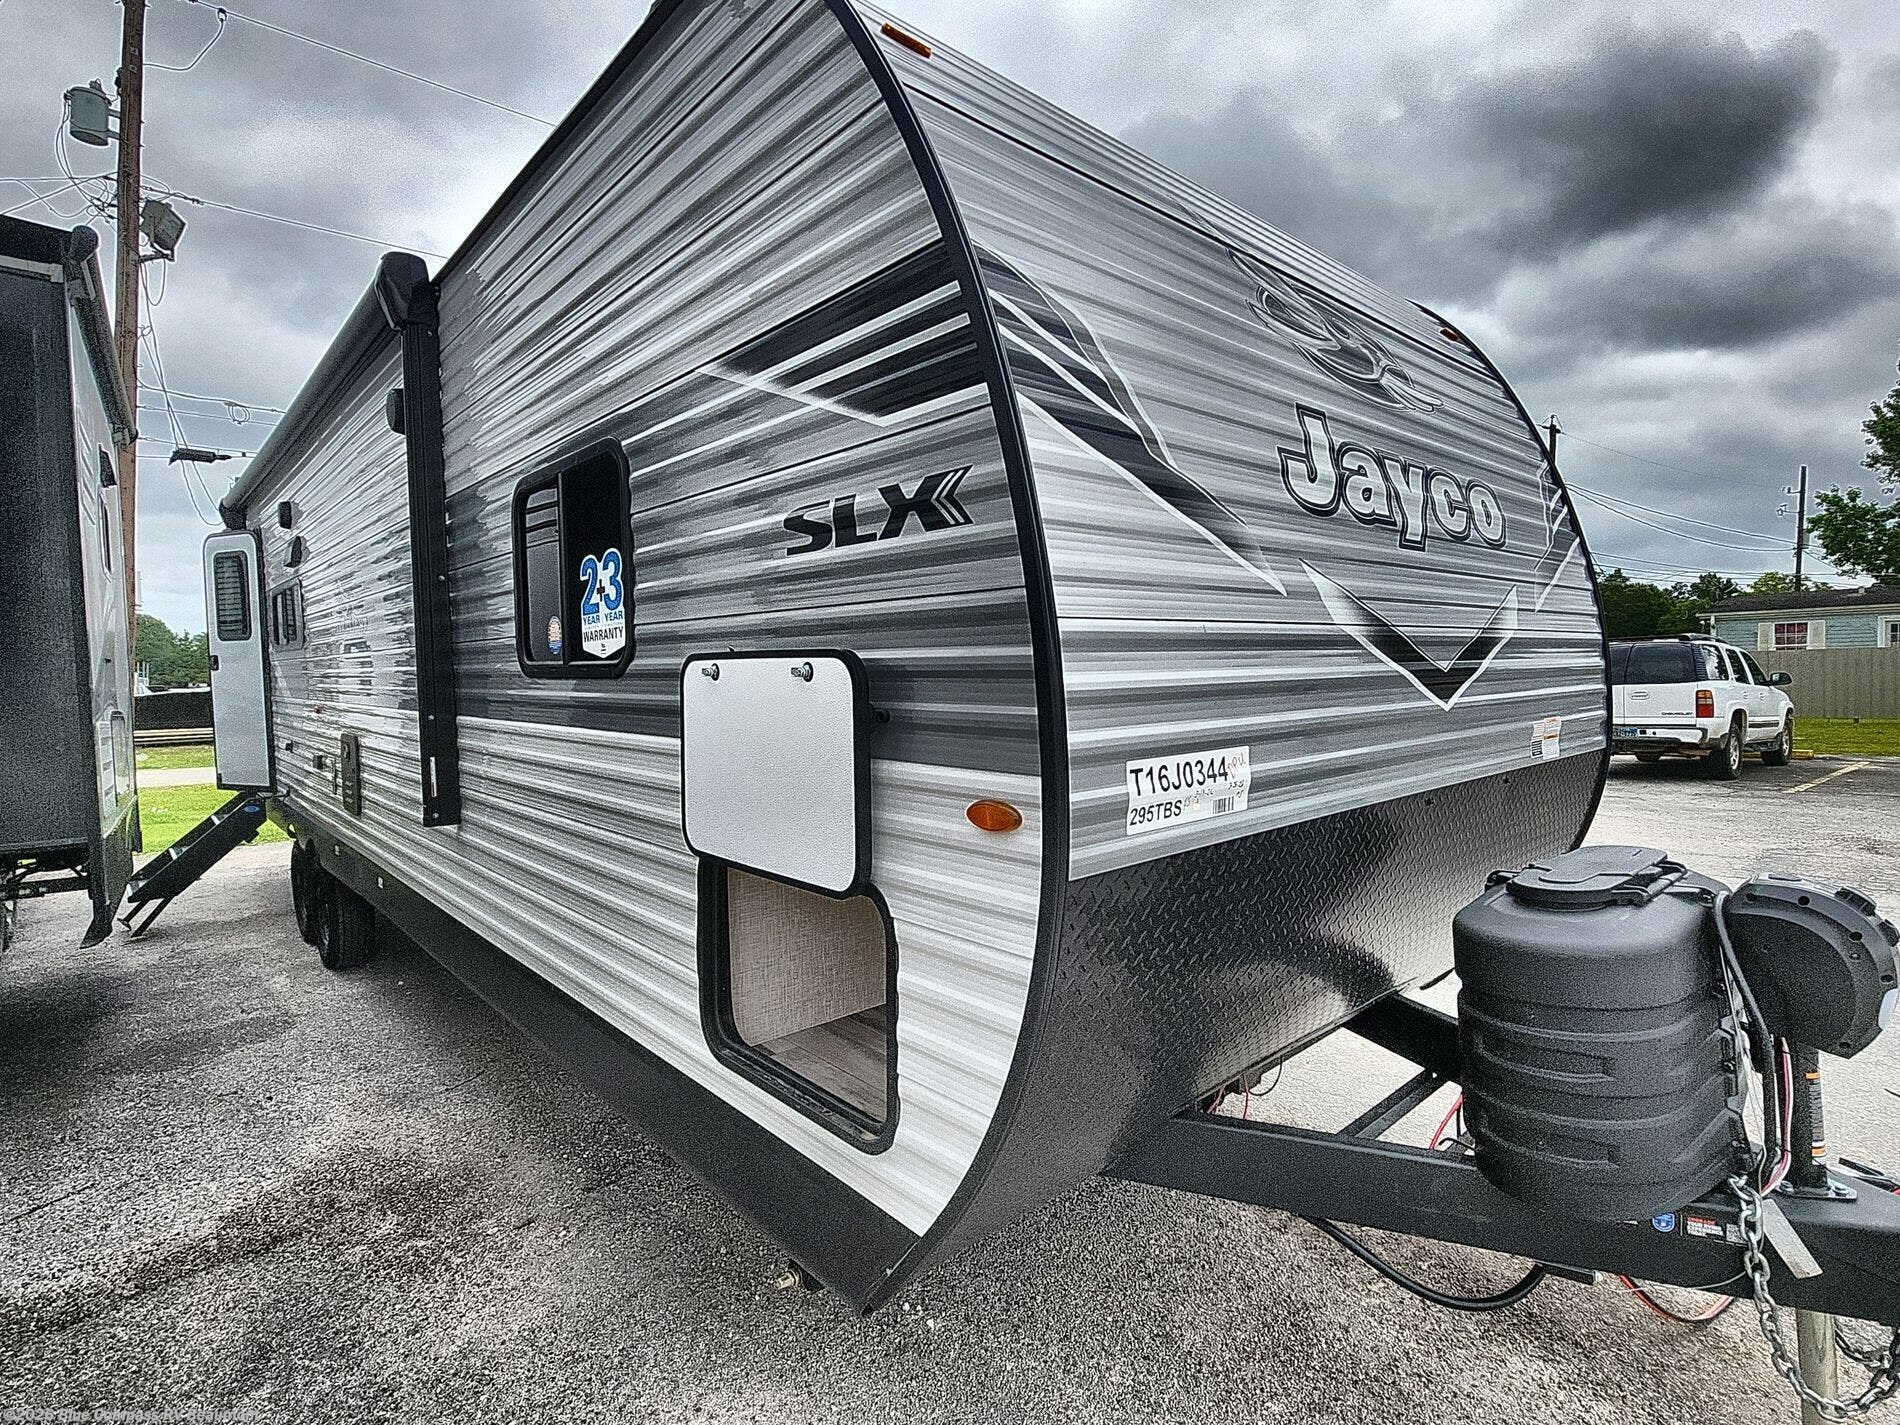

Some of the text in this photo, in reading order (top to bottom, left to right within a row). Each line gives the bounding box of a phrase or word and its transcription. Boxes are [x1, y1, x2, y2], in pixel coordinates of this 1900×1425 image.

[1276, 402, 1507, 552] Jayco
[783, 464, 974, 556] SLX
[583, 614, 600, 626] YEAR
[604, 610, 623, 623] YEAR
[583, 627, 624, 643] WARRANTY
[1130, 756, 1229, 797] T16J0344
[1129, 799, 1182, 826] 295TBS
